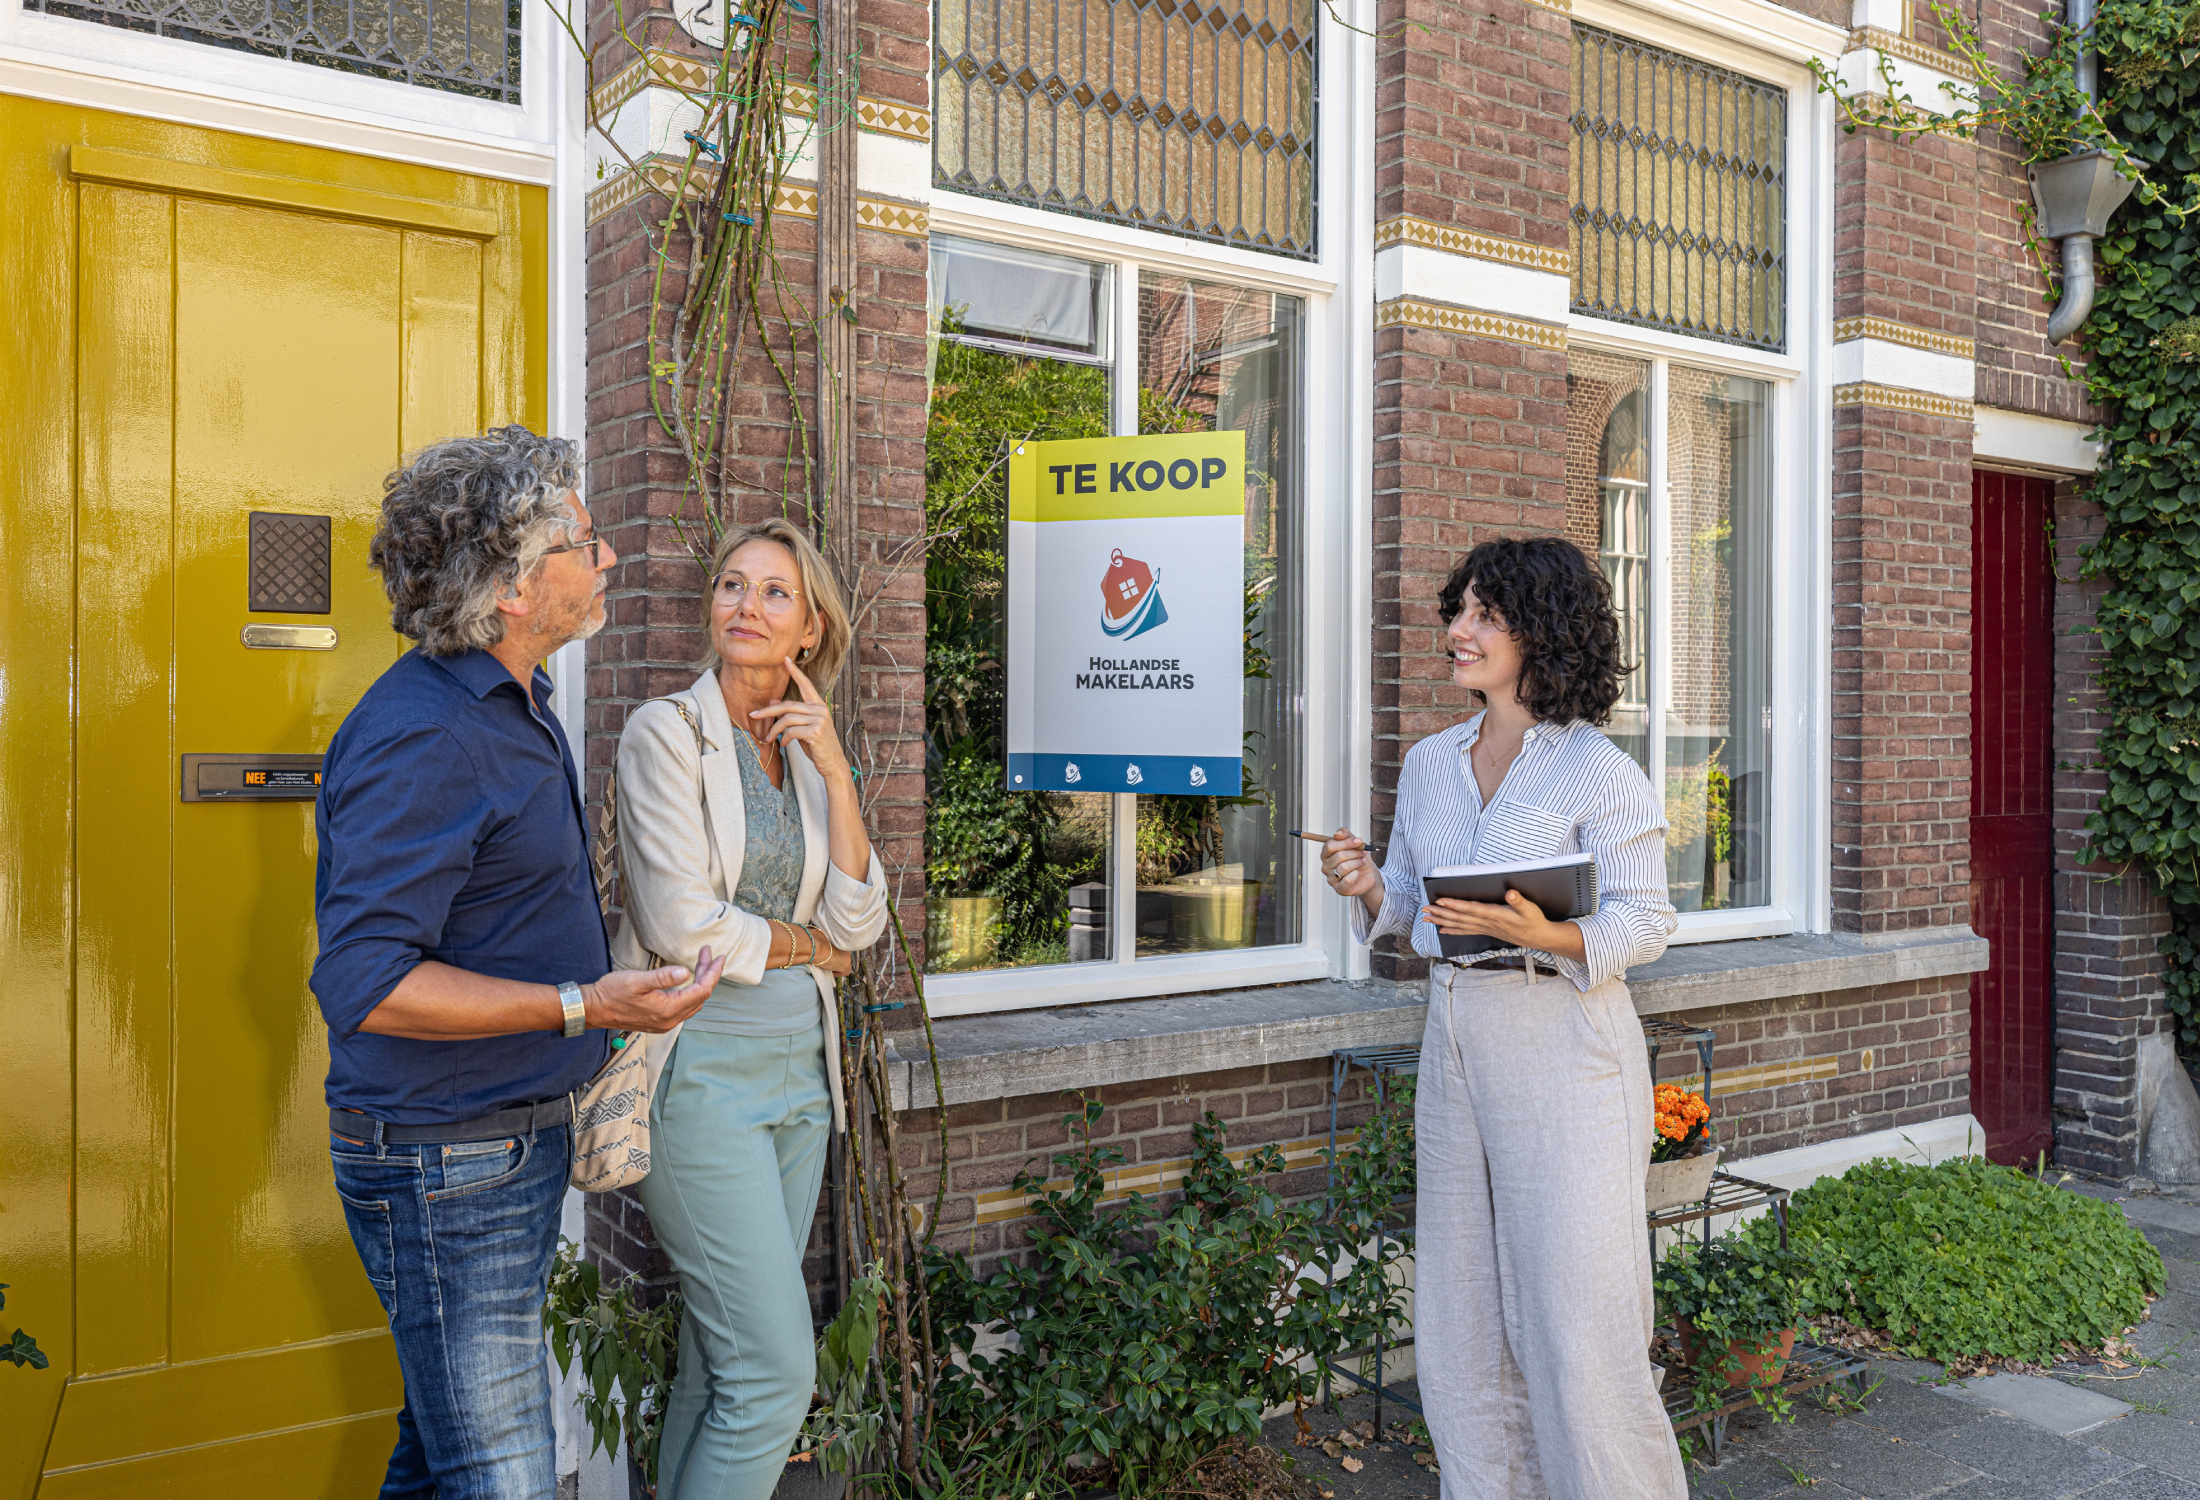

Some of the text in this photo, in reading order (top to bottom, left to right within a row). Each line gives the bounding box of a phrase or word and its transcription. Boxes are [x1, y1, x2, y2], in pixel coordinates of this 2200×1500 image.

[1049, 457, 1227, 495] TE KOOP
[1089, 656, 1180, 671] HOLLANDSE
[1076, 673, 1195, 690] MAKELAARS
[245, 771, 266, 785] NEE
